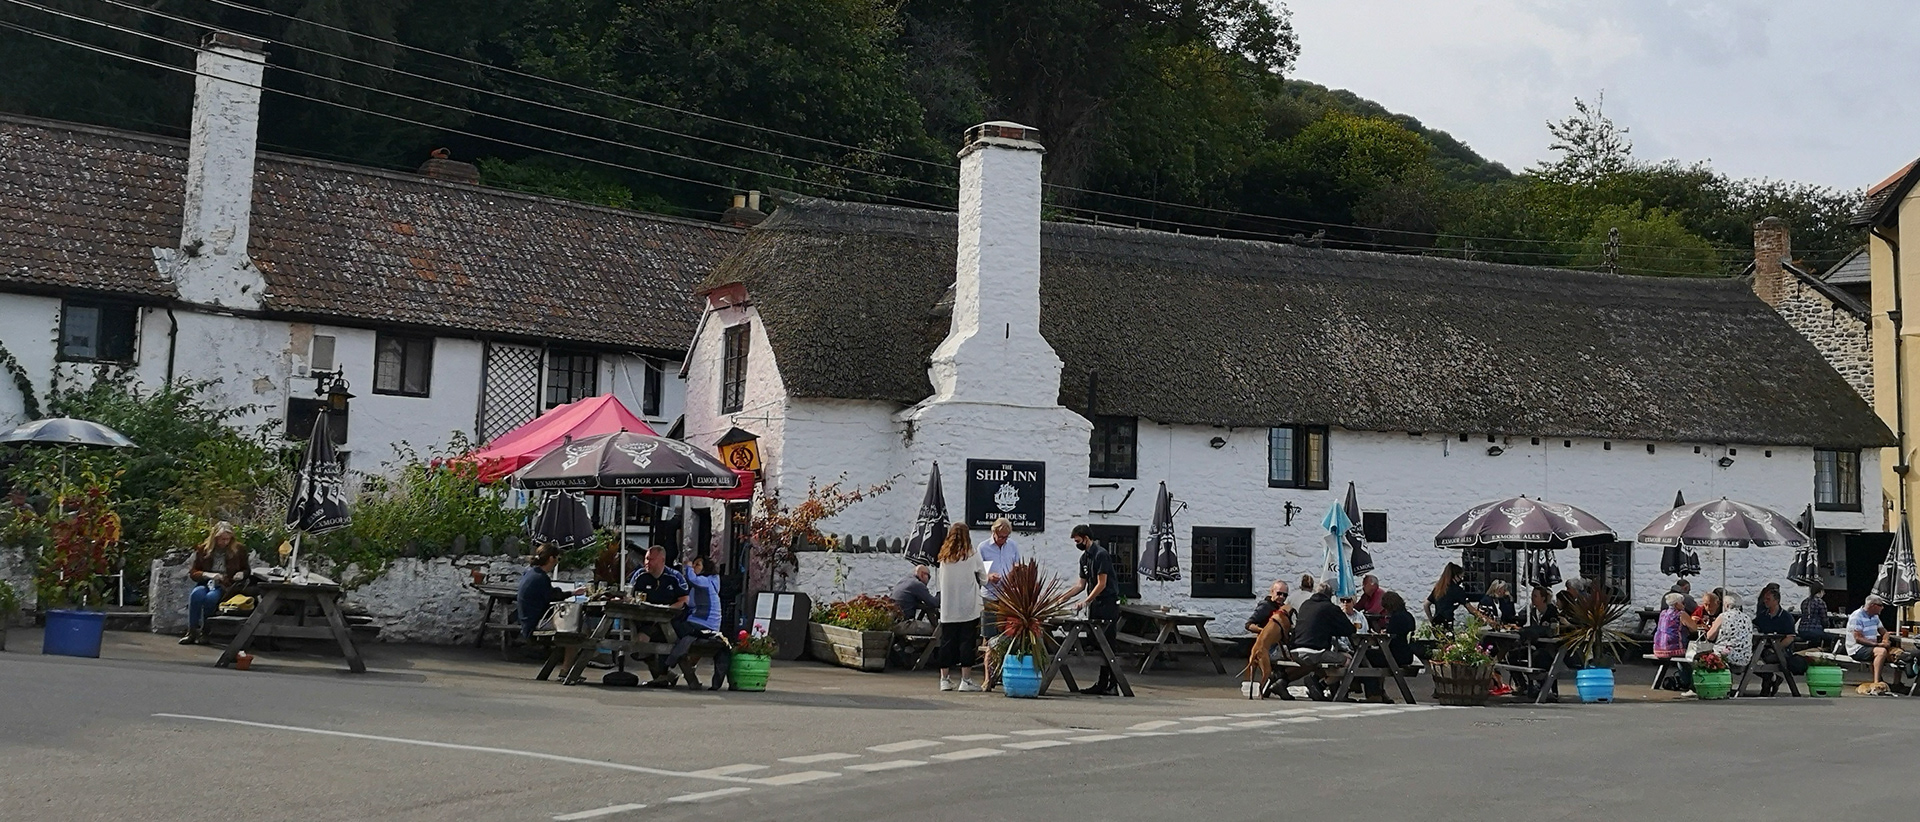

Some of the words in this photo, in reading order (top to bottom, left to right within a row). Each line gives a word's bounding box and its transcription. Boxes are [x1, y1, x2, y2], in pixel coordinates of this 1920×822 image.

[697, 476, 718, 484] EXMOOR
[718, 476, 731, 484] ALES
[976, 469, 1008, 481] SHIP
[1013, 470, 1037, 482] INN
[535, 479, 567, 488] EXMOOR
[615, 477, 652, 485] EXMOOR
[653, 476, 676, 484] ALES
[985, 512, 1003, 520] FREE
[1004, 513, 1027, 521] HOUSE
